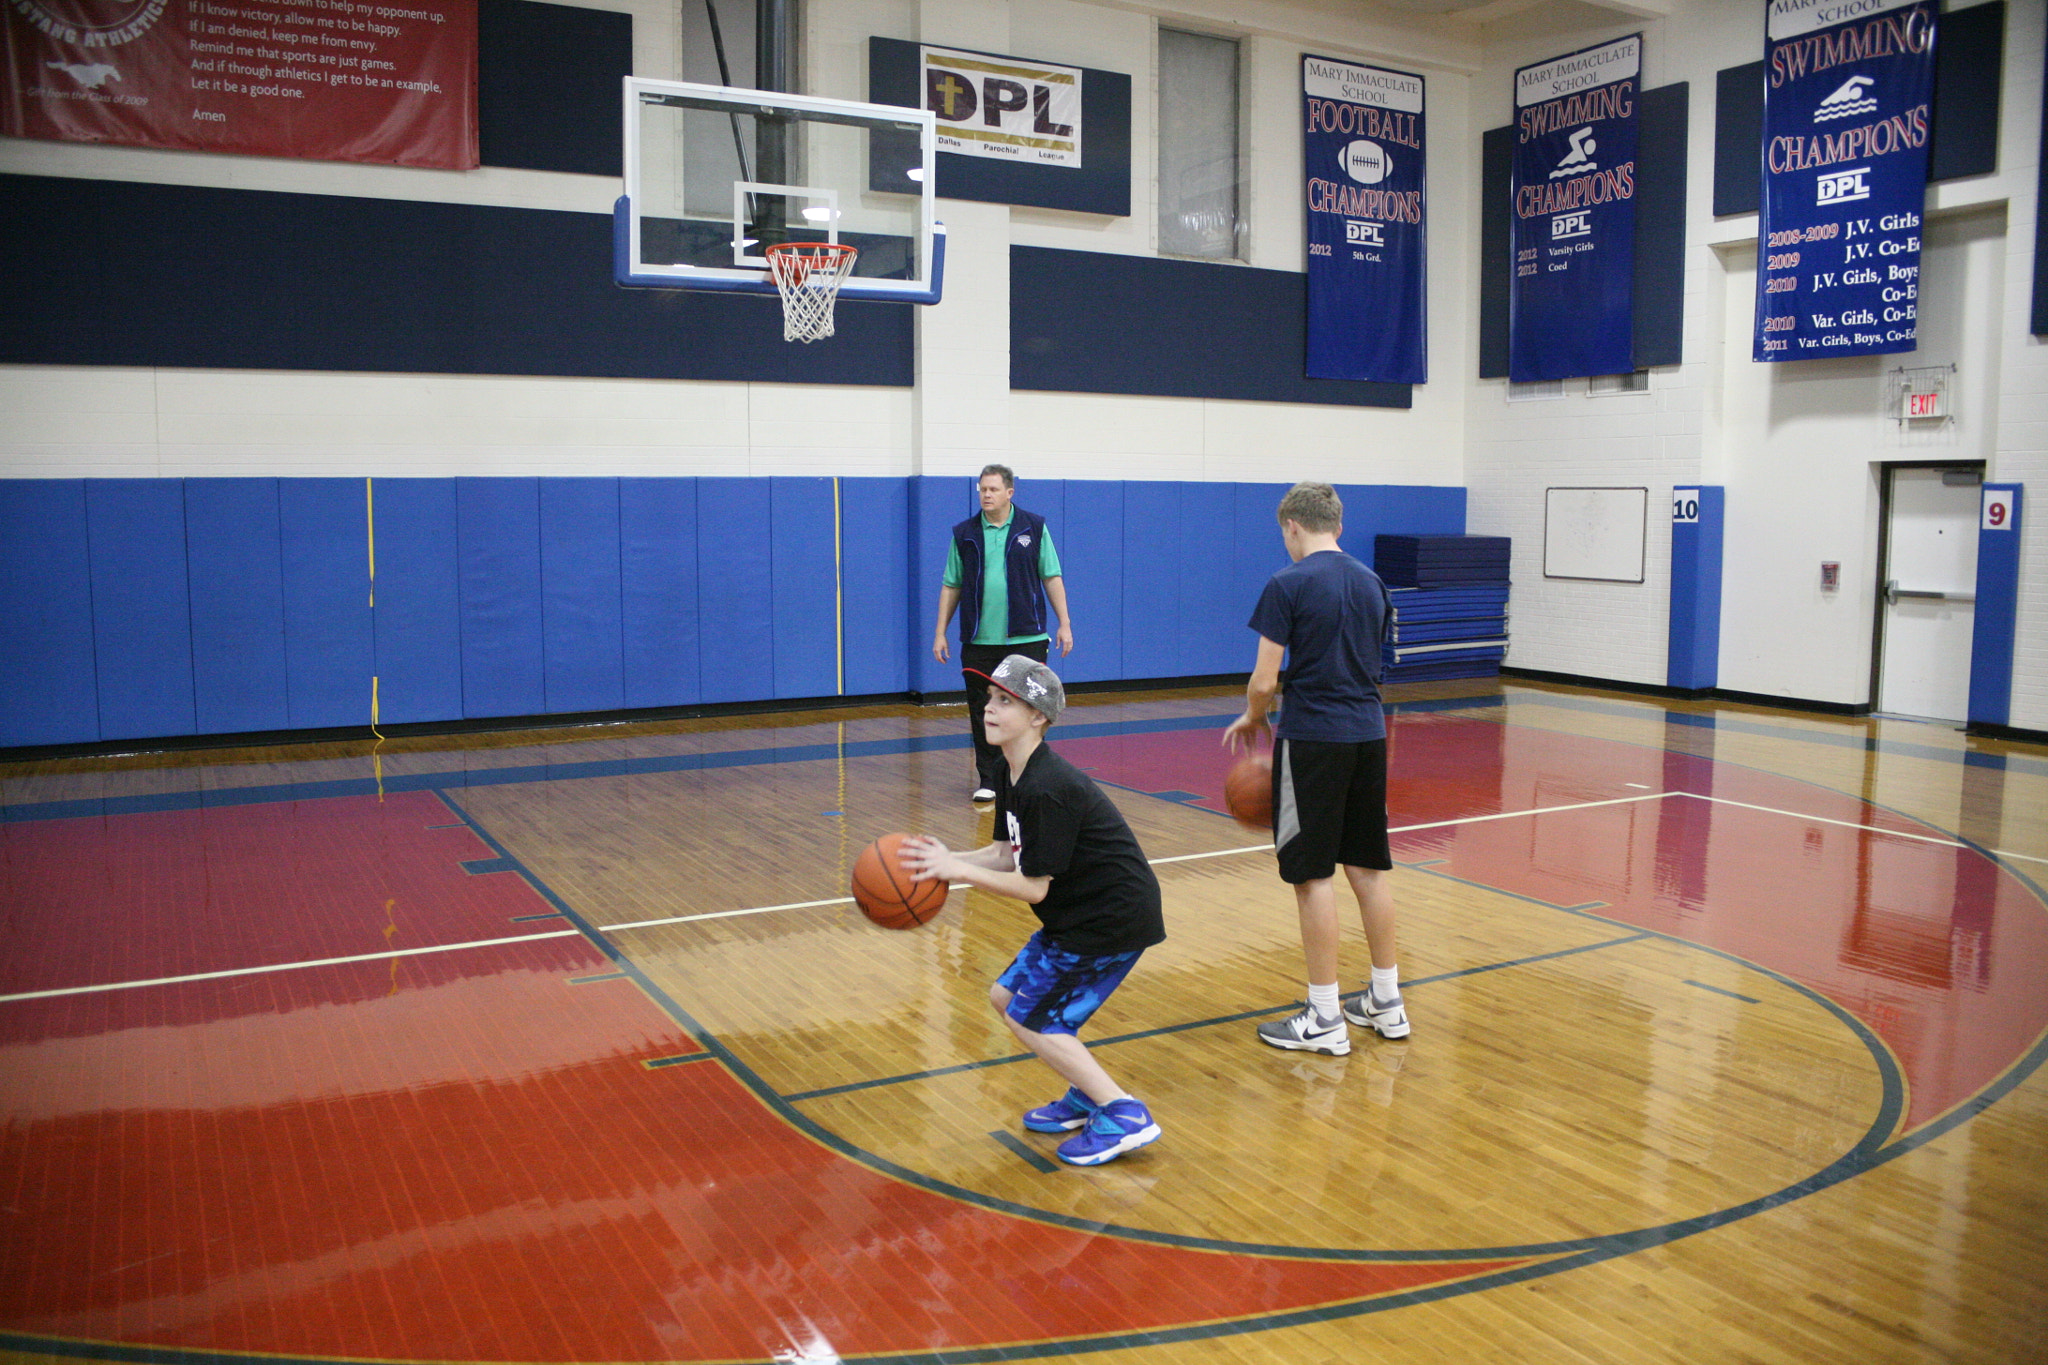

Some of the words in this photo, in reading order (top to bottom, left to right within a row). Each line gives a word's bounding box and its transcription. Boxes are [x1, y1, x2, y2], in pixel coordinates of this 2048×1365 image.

[11, 0, 77, 44] STANG
[189, 1, 197, 13] If
[208, 3, 238, 17] know
[285, 12, 314, 25] allow
[318, 18, 334, 27] me
[338, 19, 349, 29] to
[352, 18, 365, 31] be
[368, 20, 402, 38] happy.
[316, 0, 328, 8] to
[330, 0, 354, 14] help
[357, 4, 373, 16] my
[376, 6, 427, 20] opponent
[430, 12, 446, 24] up.
[1816, 0, 1884, 25] SCHOOL
[190, 20, 198, 32] If
[208, 25, 225, 34] am
[228, 24, 269, 40] denied,
[272, 28, 298, 45] keep
[302, 35, 318, 44] me
[321, 34, 347, 47] from
[350, 40, 377, 53] envy.
[1771, 9, 1930, 88] SWIMMING
[190, 39, 234, 54] Remind
[236, 47, 254, 56] me
[257, 46, 279, 59] that
[282, 52, 316, 63] sports
[319, 55, 336, 64] are
[339, 54, 358, 68] just
[361, 59, 396, 71] games.
[1521, 69, 1554, 87] MARY
[1556, 44, 1635, 77] IMMACULATE
[191, 59, 214, 72] And
[217, 60, 226, 72] if
[228, 62, 272, 80] through
[274, 66, 321, 82] athletics
[331, 74, 348, 86] get
[350, 75, 362, 85] to
[365, 74, 378, 87] be
[381, 78, 393, 88] an
[396, 80, 442, 94] example,
[191, 77, 209, 90] Let
[213, 80, 221, 90] it
[224, 80, 238, 92] be
[241, 84, 247, 93] a
[250, 84, 278, 97] good
[281, 88, 304, 98] one.
[1310, 62, 1343, 82] MARY
[1346, 70, 1418, 94] IMMACULATE
[1552, 72, 1600, 95] SCHOOL
[72, 89, 87, 100] the
[113, 95, 124, 104] of
[125, 96, 148, 106] 2009
[926, 68, 1073, 137] DPL
[1342, 84, 1388, 104] SCHOOL
[192, 108, 226, 122] Amen
[1308, 98, 1420, 149] FOOTBALL
[1520, 81, 1632, 144] SWIMMING
[938, 137, 961, 147] Dallas
[984, 144, 1019, 155] Parochial
[1038, 151, 1065, 161] League
[1768, 104, 1928, 174] CHAMPIONS
[1517, 162, 1634, 219] CHAMPIONS
[1817, 174, 1870, 200] DPL
[1308, 177, 1420, 224] CHAMPIONS
[1347, 224, 1384, 242] DPL
[1552, 215, 1591, 236] DPL
[1768, 223, 1839, 247] 2008-2009
[1845, 218, 1874, 240] J.V.
[1879, 212, 1920, 231] Girls
[1309, 244, 1332, 256] 2012
[1352, 251, 1364, 261] 5th
[1518, 248, 1538, 262] 2012
[1549, 245, 1573, 256] Varsity
[1575, 241, 1594, 252] Girls
[1767, 252, 1800, 270] 2009
[1844, 243, 1873, 264] J.V.
[1518, 263, 1538, 277] 2012
[1548, 262, 1568, 272] Coed
[1766, 276, 1797, 293] 2010
[1813, 272, 1838, 292] J.V.
[1842, 268, 1882, 285] Girls,
[1888, 265, 1918, 283] Boys
[1882, 284, 1917, 302] Co-E
[1764, 316, 1796, 332] 2010
[1812, 314, 1836, 329] Var.
[1841, 309, 1878, 326] Girls,
[1763, 339, 1788, 351] 2011
[1799, 338, 1819, 348] Var.
[1822, 334, 1852, 347] Girls,
[1854, 332, 1883, 345] Boys,
[1910, 393, 1938, 415] EXIT
[1673, 500, 1698, 520] 10
[1989, 502, 2006, 526] 9
